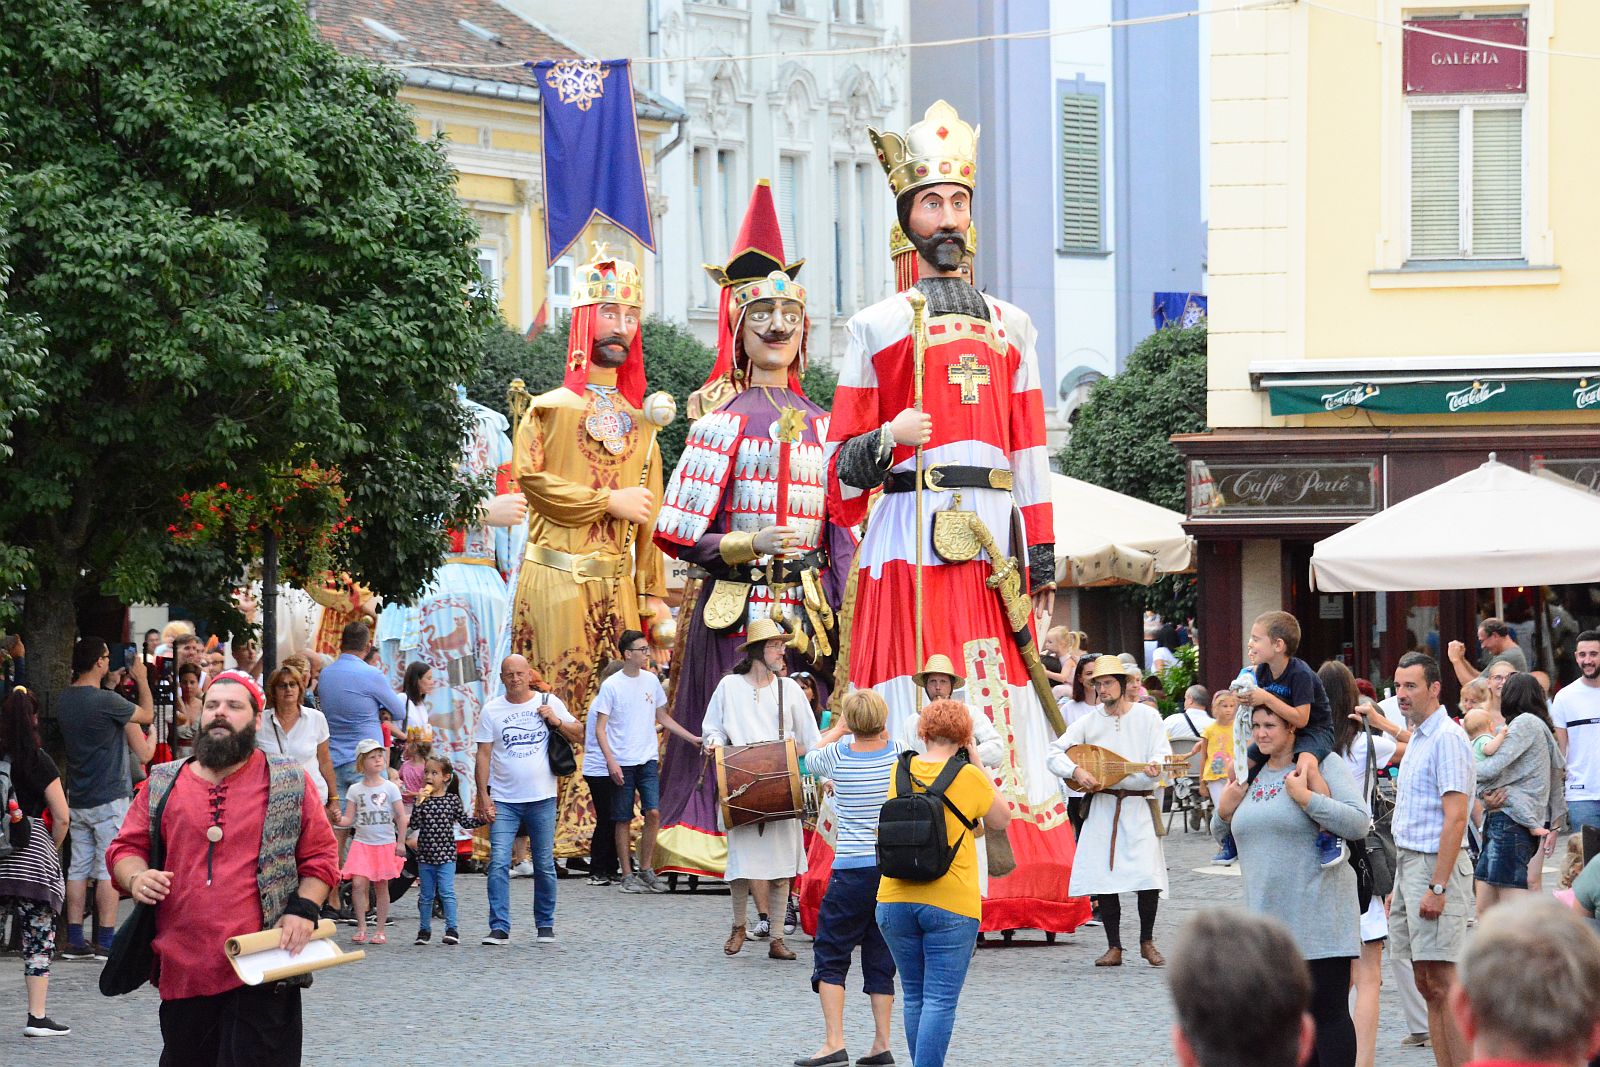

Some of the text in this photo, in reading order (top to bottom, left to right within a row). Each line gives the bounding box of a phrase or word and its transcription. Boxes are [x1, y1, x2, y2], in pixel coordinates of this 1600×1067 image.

[1431, 51, 1500, 65] GALERIA
[502, 712, 519, 724] WEST
[502, 731, 543, 746] Garage
[360, 810, 391, 826] ME
